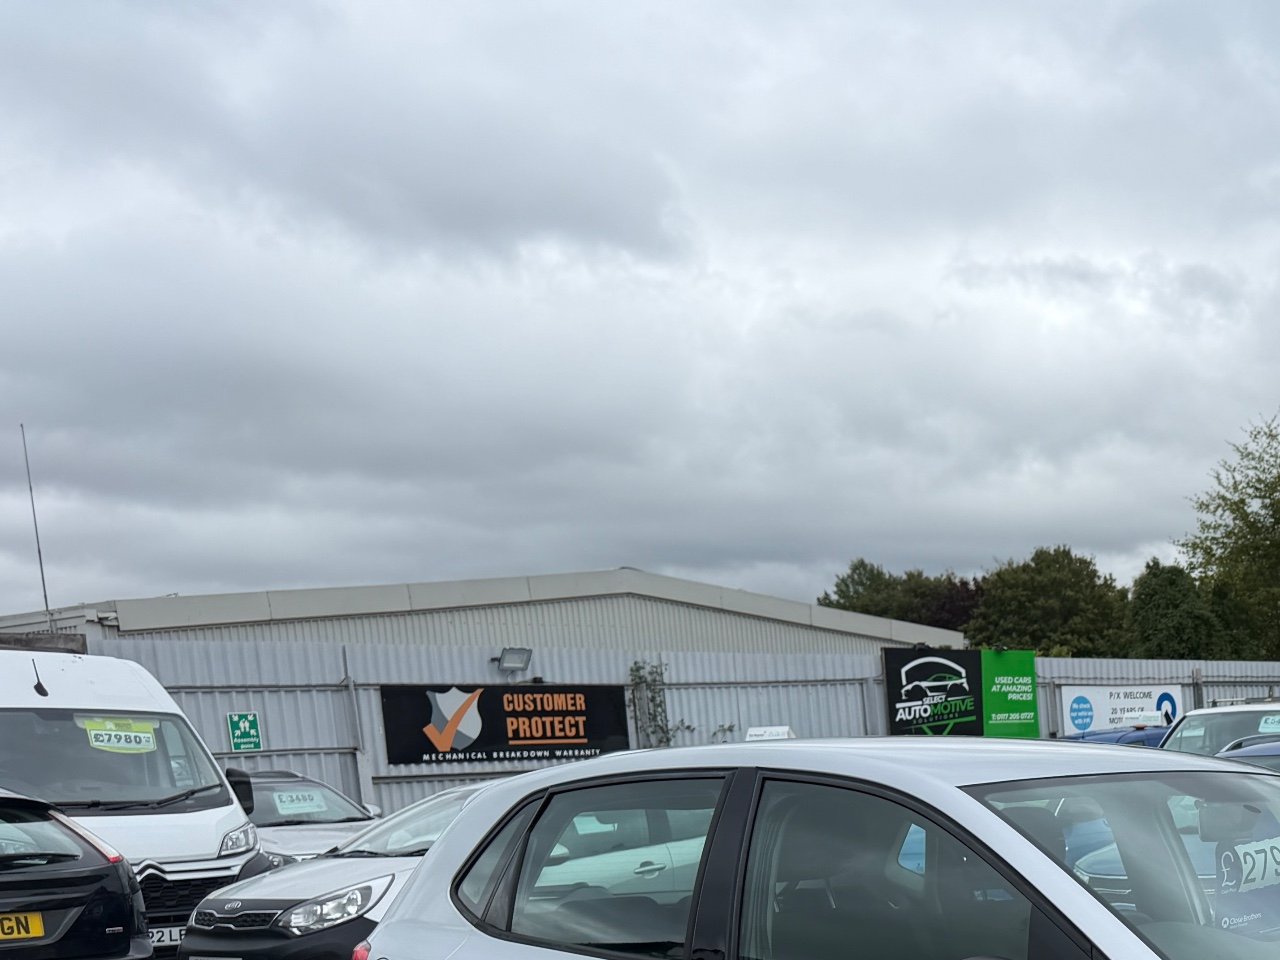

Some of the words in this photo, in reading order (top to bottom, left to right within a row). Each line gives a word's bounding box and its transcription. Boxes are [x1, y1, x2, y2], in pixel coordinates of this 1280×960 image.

[503, 693, 586, 712] CUSTOMER
[922, 695, 946, 705] SELECT
[1123, 691, 1152, 699] WELCOME
[895, 698, 975, 722] AUTOMOTIVE
[506, 716, 587, 738] PROTECT
[422, 752, 487, 761] MECHANICAL
[493, 750, 550, 759] BREAKDOWN
[555, 748, 601, 758] WARRANTY
